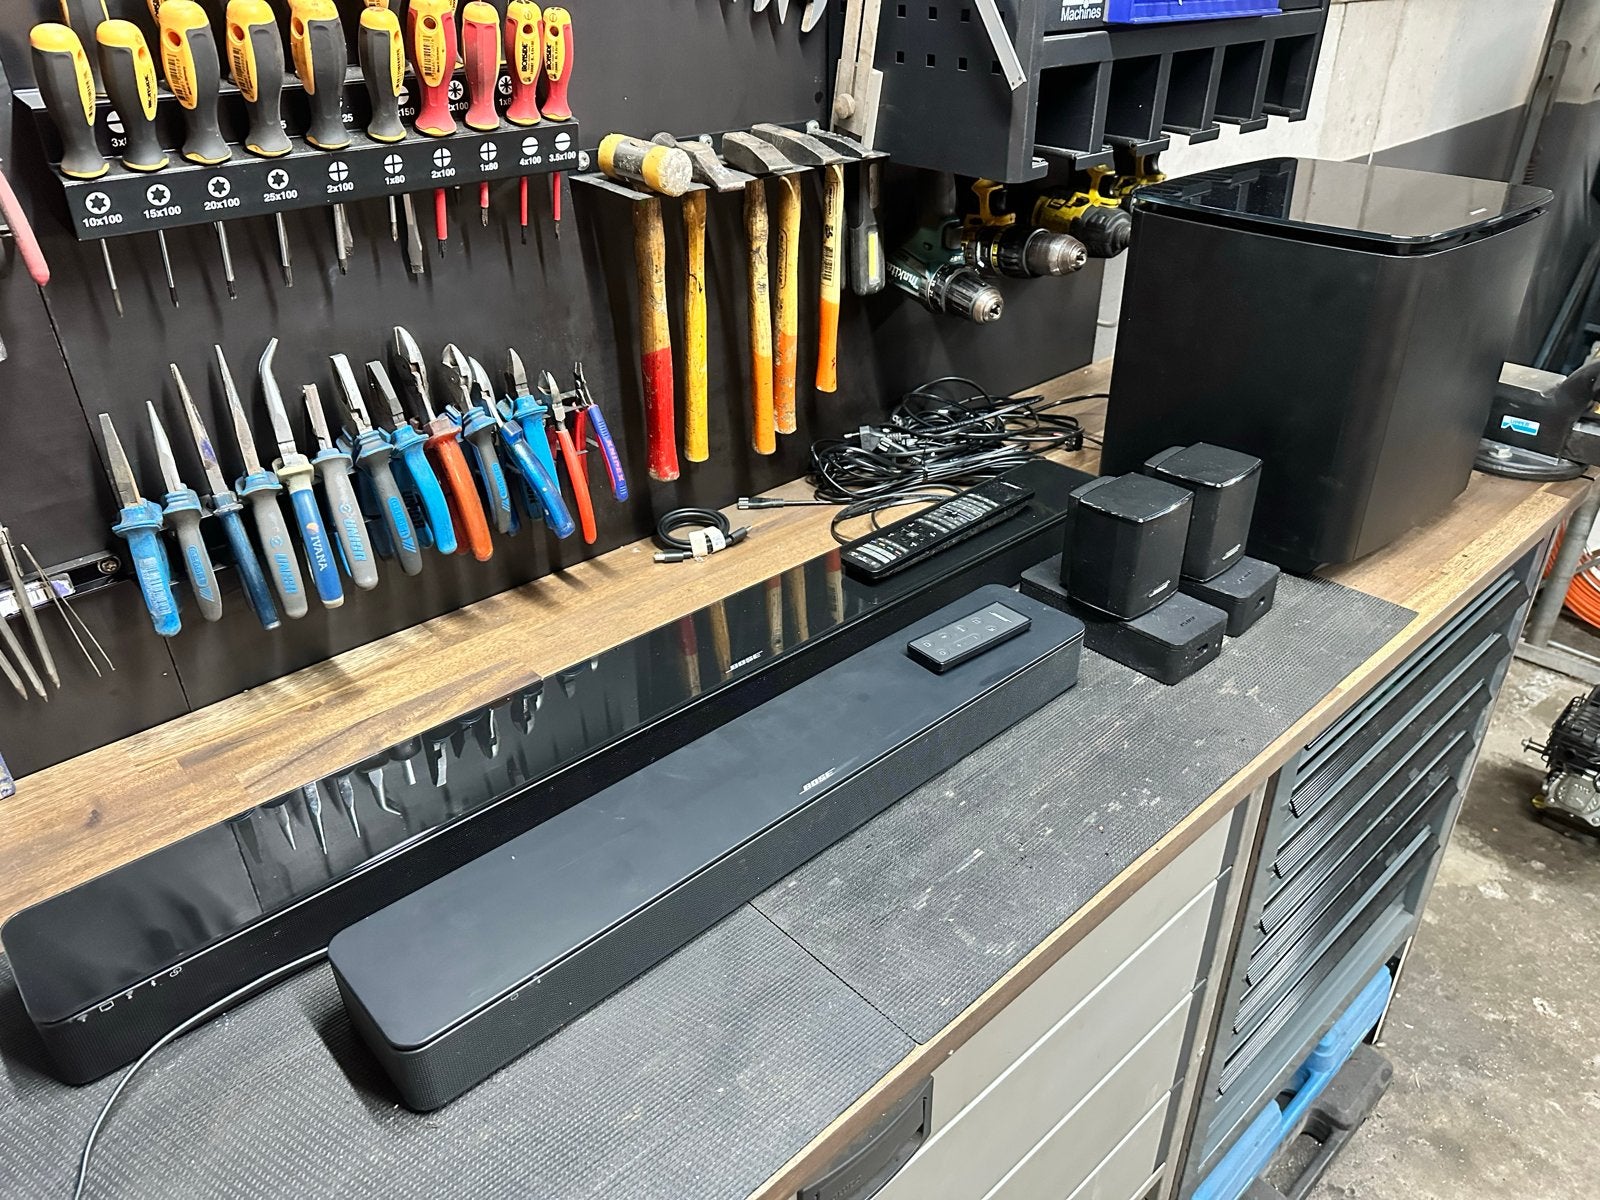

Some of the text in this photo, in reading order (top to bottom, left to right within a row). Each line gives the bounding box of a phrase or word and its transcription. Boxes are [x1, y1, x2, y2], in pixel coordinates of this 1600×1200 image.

[1060, 6, 1102, 22] Machines
[449, 101, 469, 112] x100
[499, 97, 512, 106] 1x8
[519, 155, 542, 166] 4x100
[549, 151, 577, 163] 3.5x100
[431, 167, 456, 179] 2x100
[479, 161, 499, 172] 1x80
[384, 174, 406, 185] 1x80
[326, 182, 354, 194] 2x100
[263, 189, 298, 203] 25x100
[203, 197, 241, 211] 20x100
[143, 205, 182, 219] 15x100
[82, 213, 123, 228] 10x100
[606, 439, 625, 482] KNIPEX
[310, 535, 328, 572] IVANA
[727, 651, 762, 673] BOSE
[800, 768, 835, 794] BOSE
